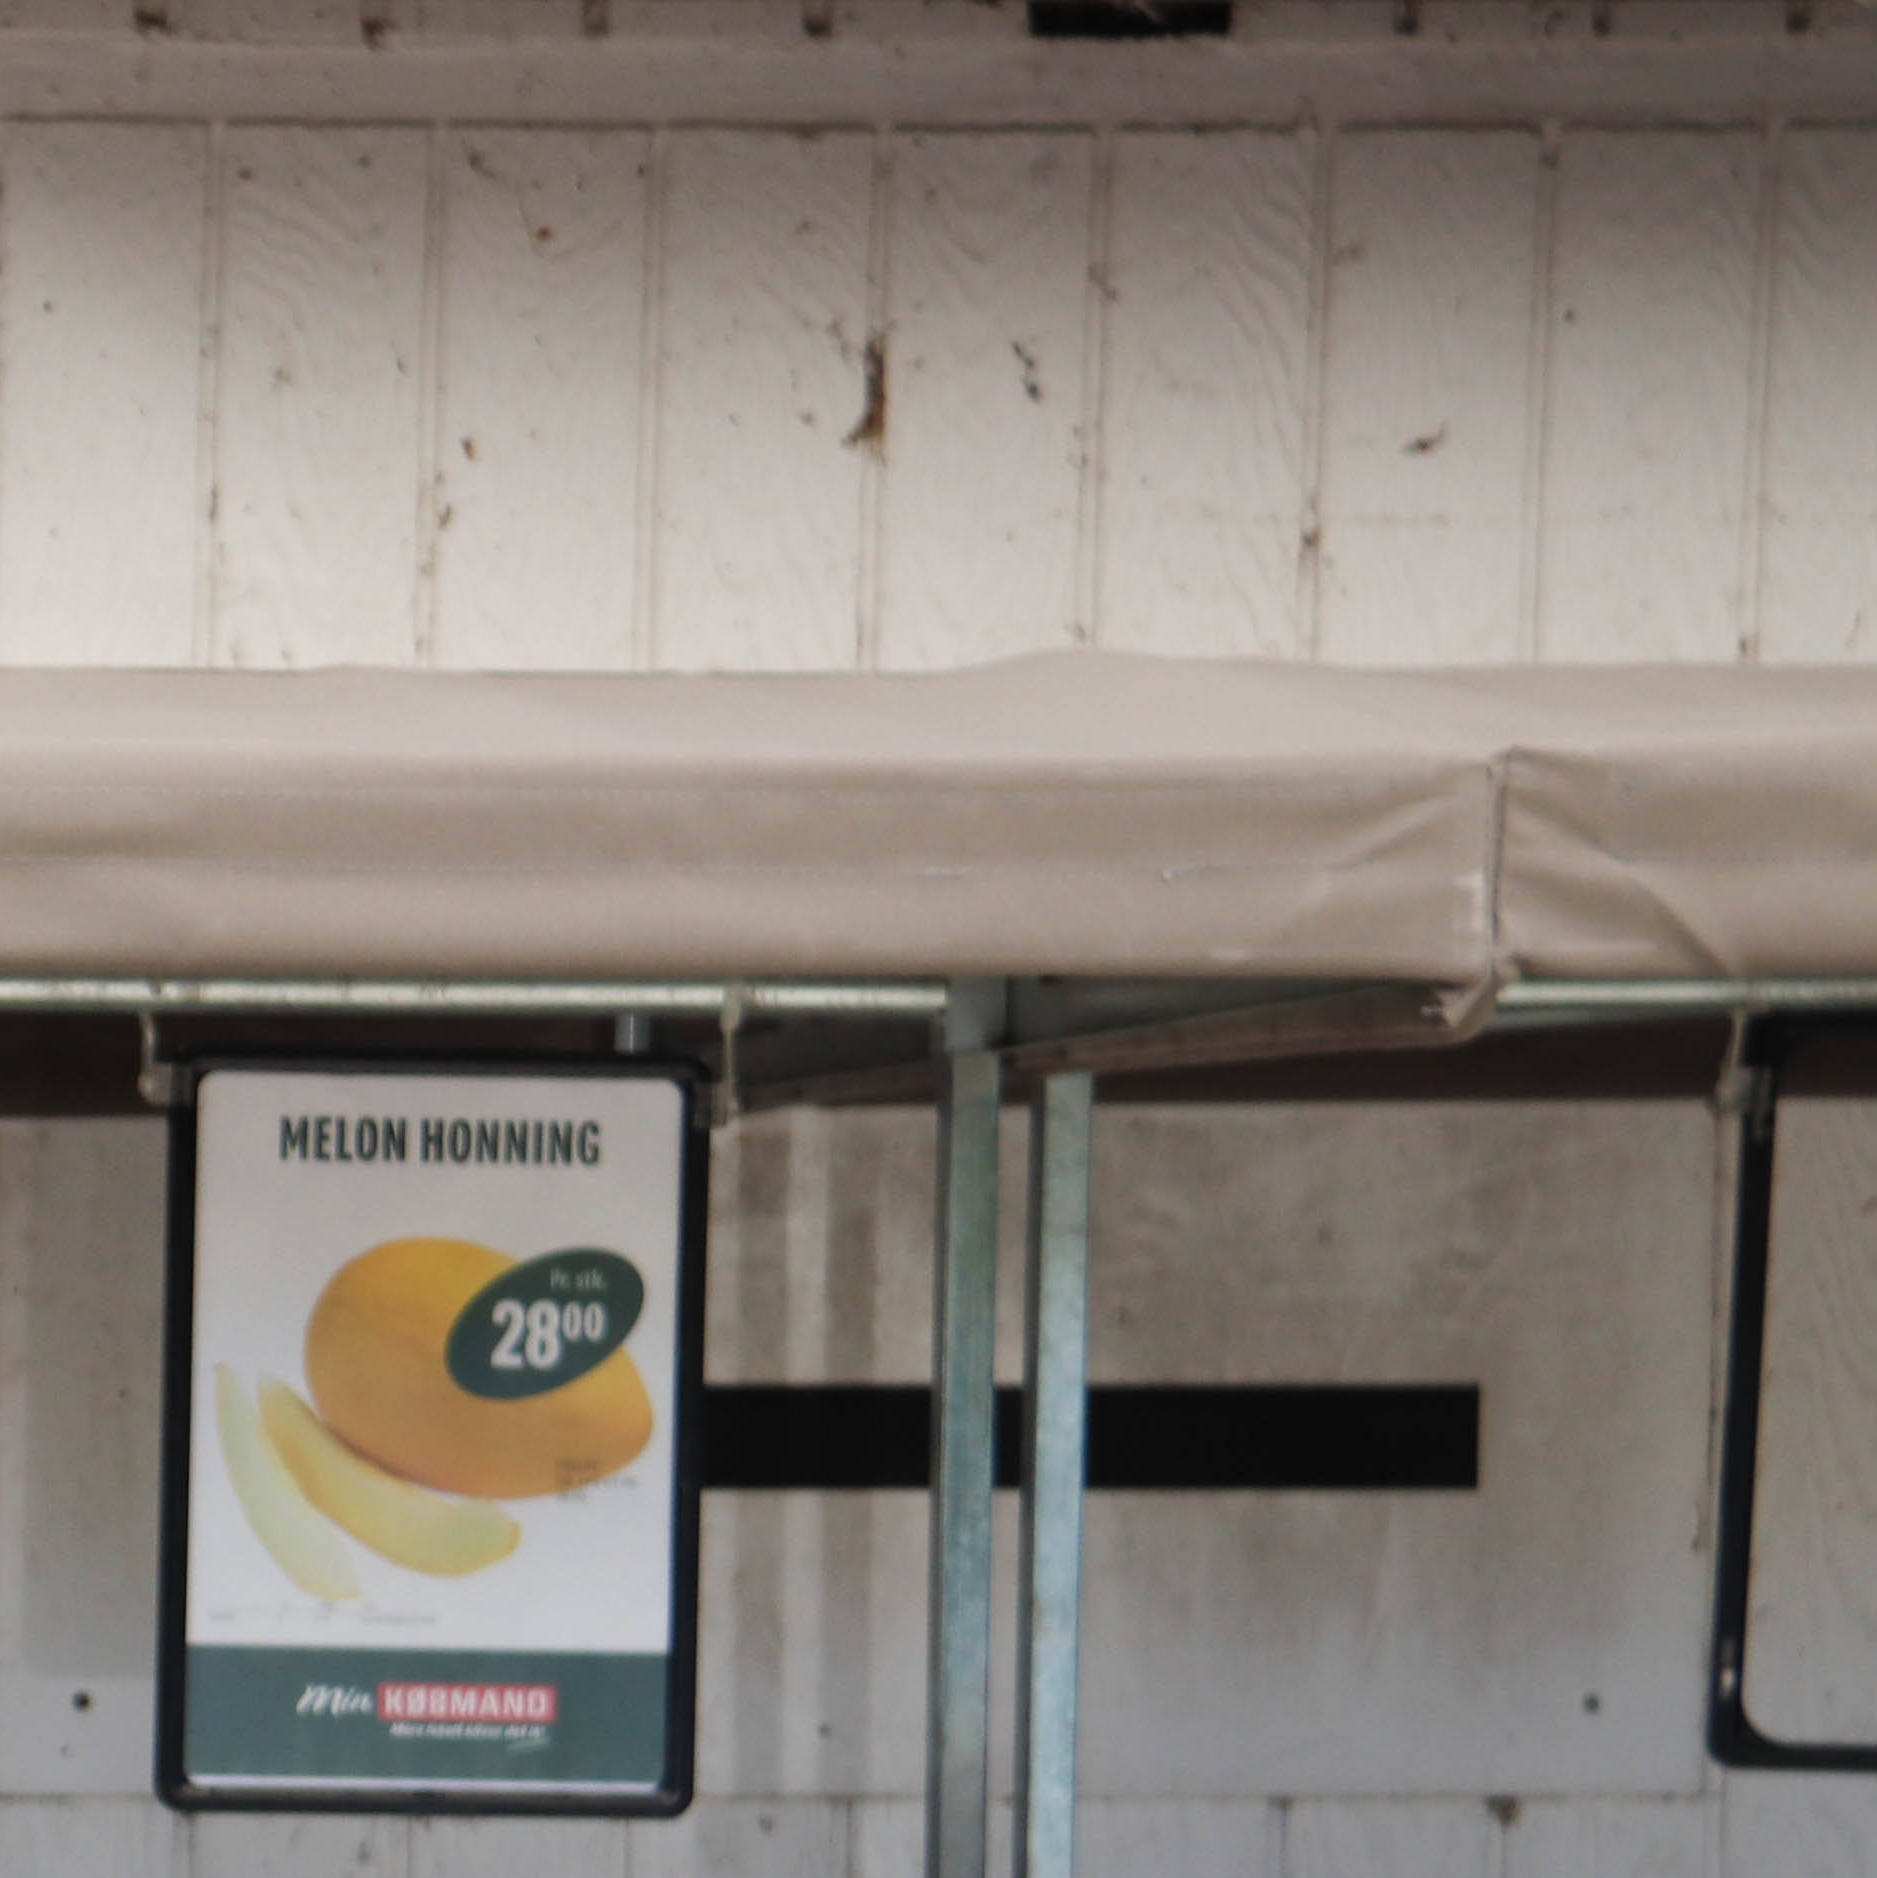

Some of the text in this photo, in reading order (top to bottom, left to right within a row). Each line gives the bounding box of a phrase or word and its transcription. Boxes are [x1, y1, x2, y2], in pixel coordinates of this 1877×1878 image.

[278, 1115, 601, 1165] MELON HONNING
[296, 1683, 549, 1719] Min KØBMAND
